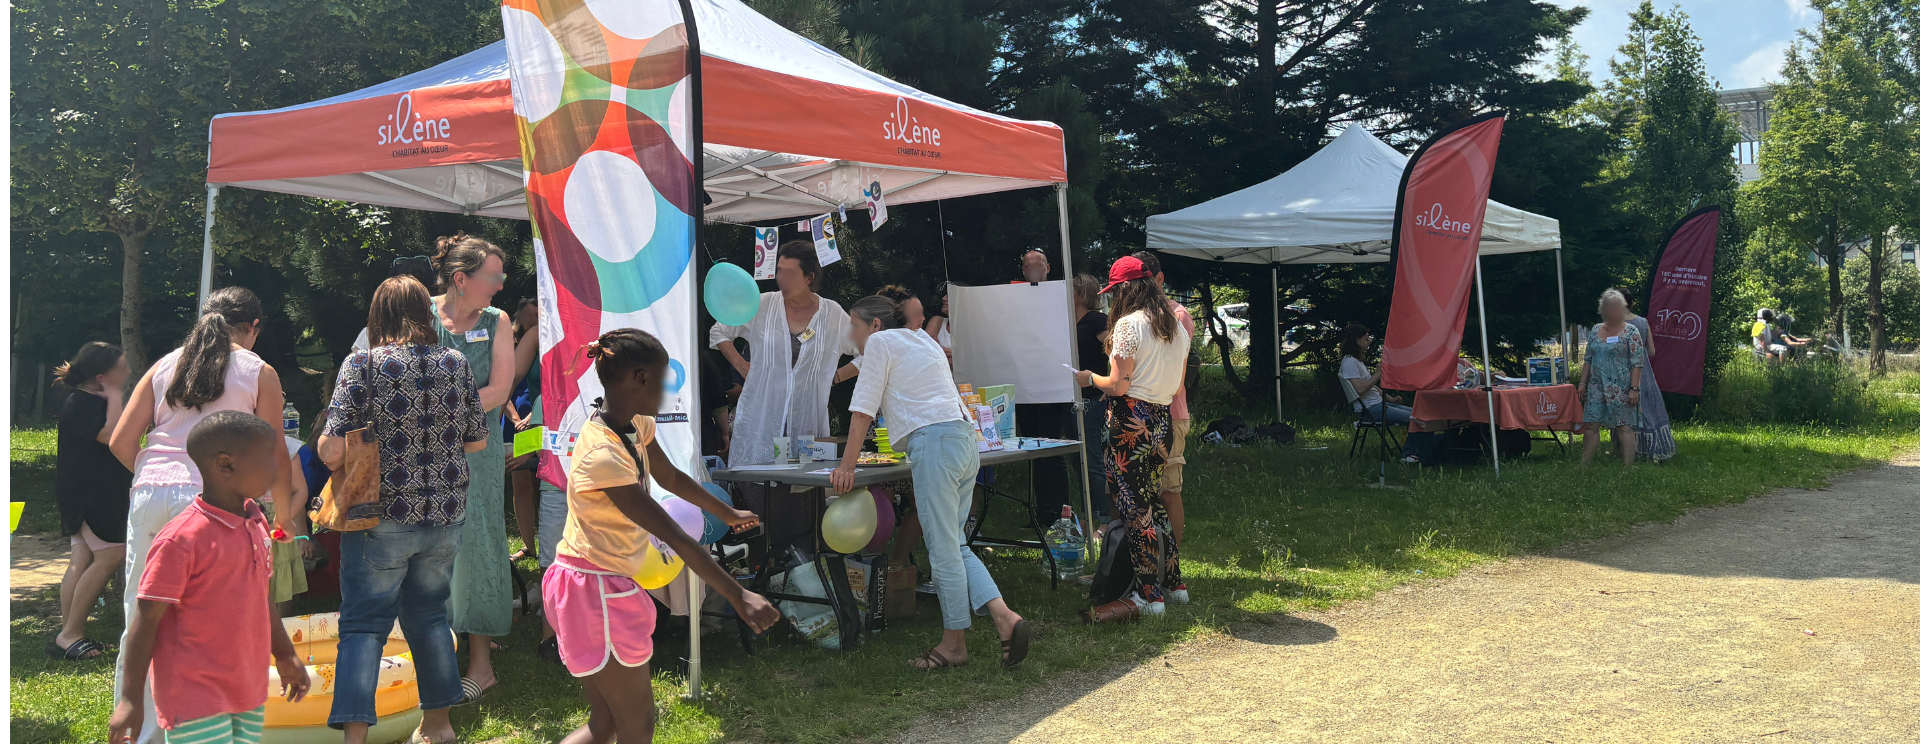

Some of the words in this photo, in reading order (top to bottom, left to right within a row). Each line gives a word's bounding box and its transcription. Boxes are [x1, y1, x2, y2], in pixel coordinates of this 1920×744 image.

[378, 94, 450, 145] silène
[883, 96, 941, 147] silène
[392, 148, 419, 157] L'HABITAT
[420, 146, 430, 154] AU
[1415, 202, 1471, 234] silène
